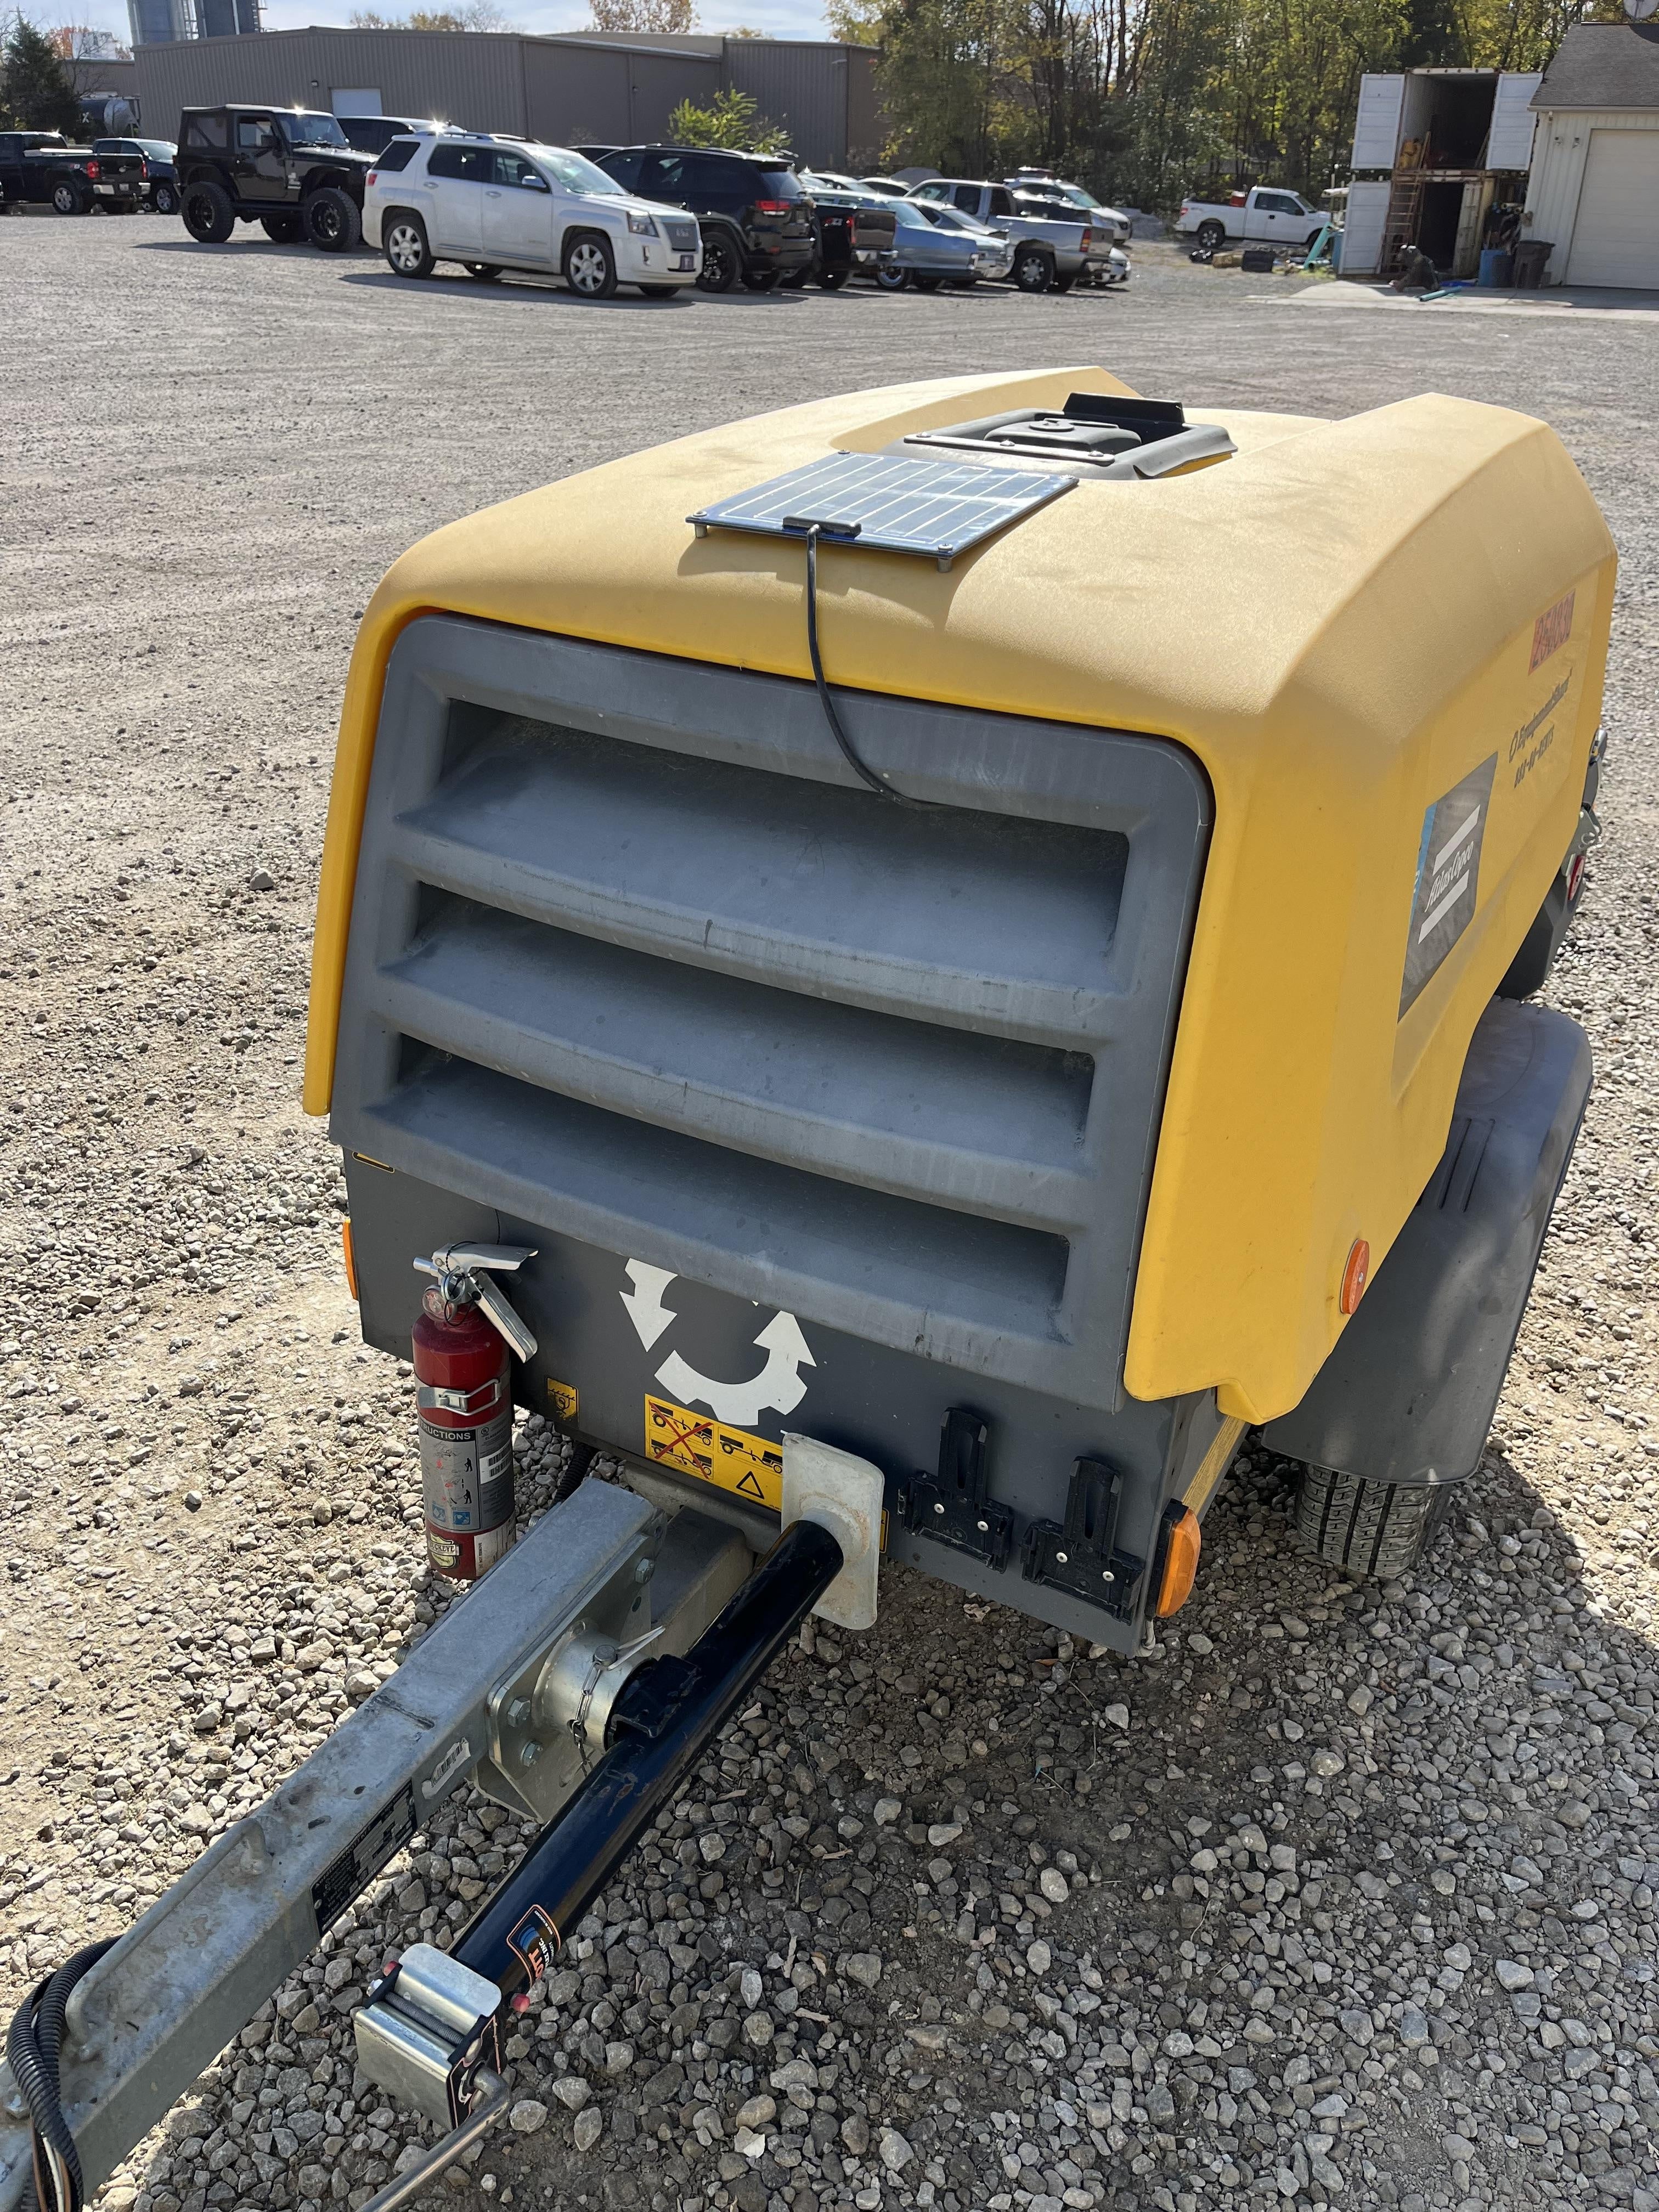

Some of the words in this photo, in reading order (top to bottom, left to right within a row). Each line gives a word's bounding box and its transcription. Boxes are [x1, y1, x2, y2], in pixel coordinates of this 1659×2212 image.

[1424, 867, 1452, 913] Atlas
[1451, 840, 1474, 881] Copco
[539, 1938, 548, 1954] INC.
[528, 1948, 544, 1978] OTT
